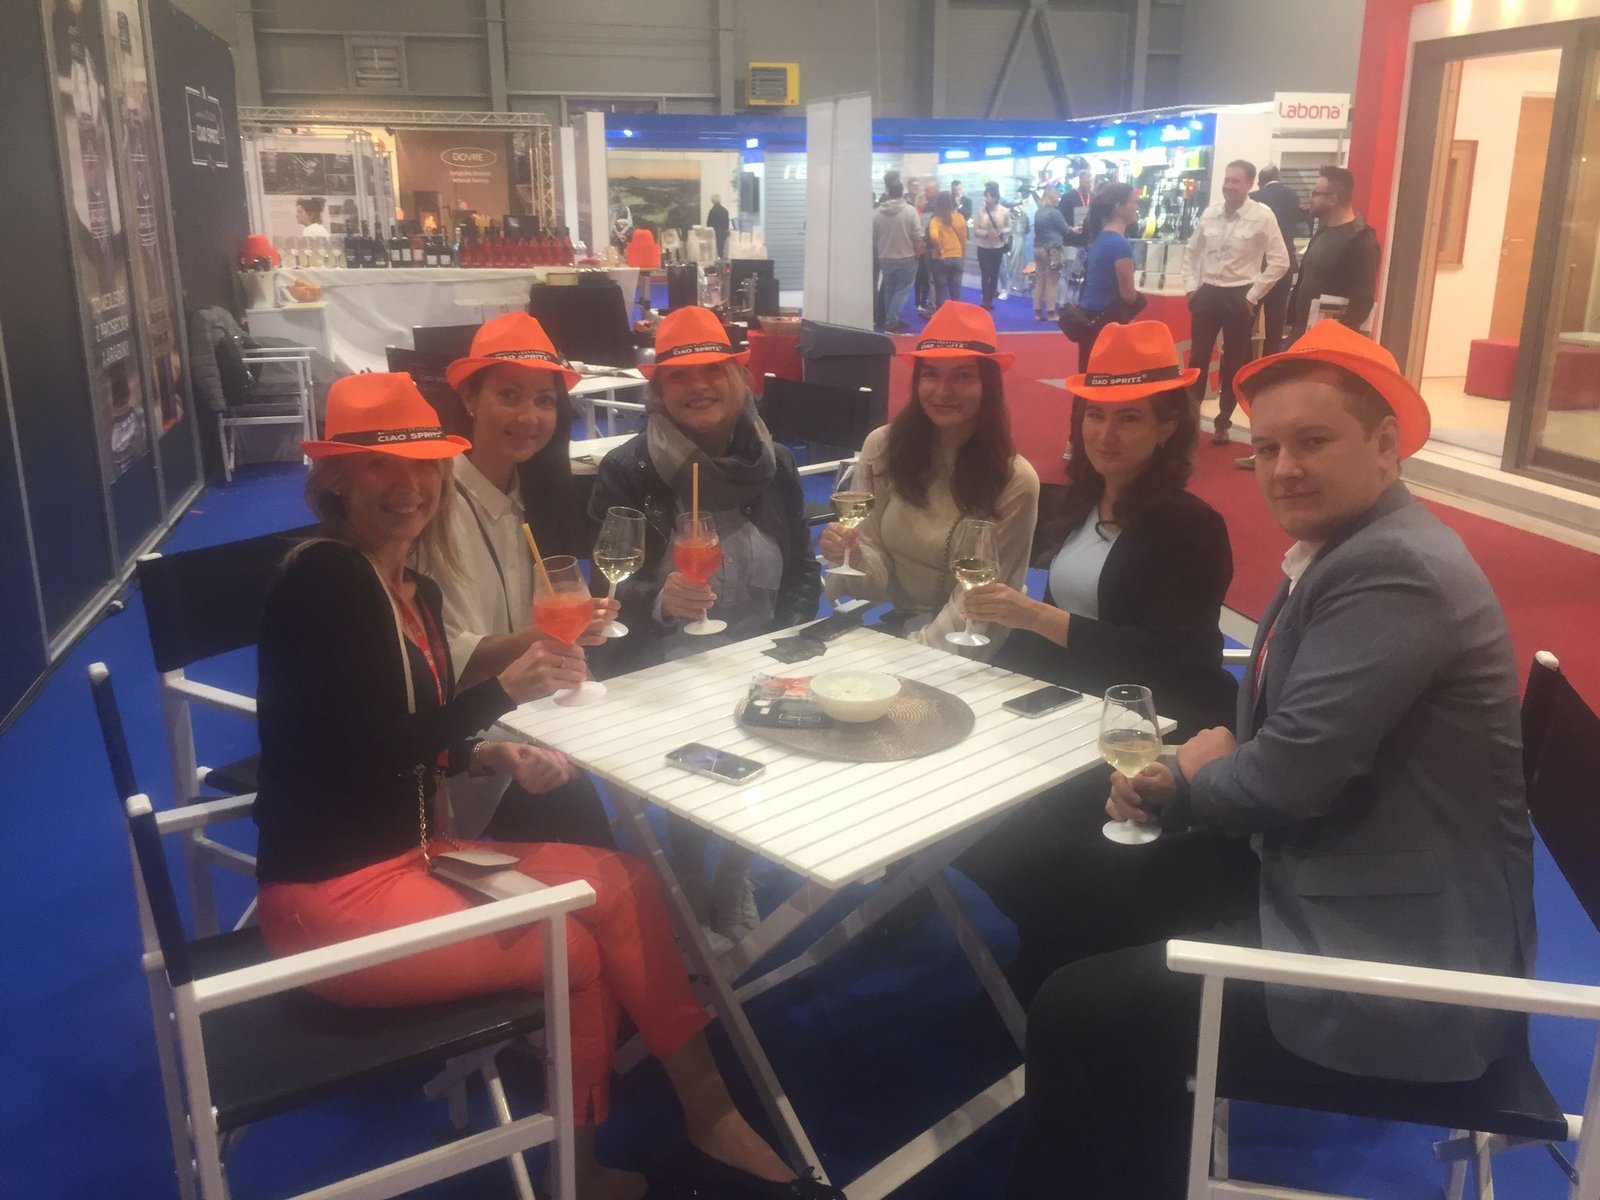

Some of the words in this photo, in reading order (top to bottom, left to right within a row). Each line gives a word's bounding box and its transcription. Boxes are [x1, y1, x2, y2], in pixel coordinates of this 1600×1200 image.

[1278, 101, 1341, 120] Labona
[672, 348, 693, 356] CIAO
[1110, 376, 1142, 385] SPRITZ
[377, 433, 407, 442] CIAO
[410, 430, 442, 440] SPRITZ
